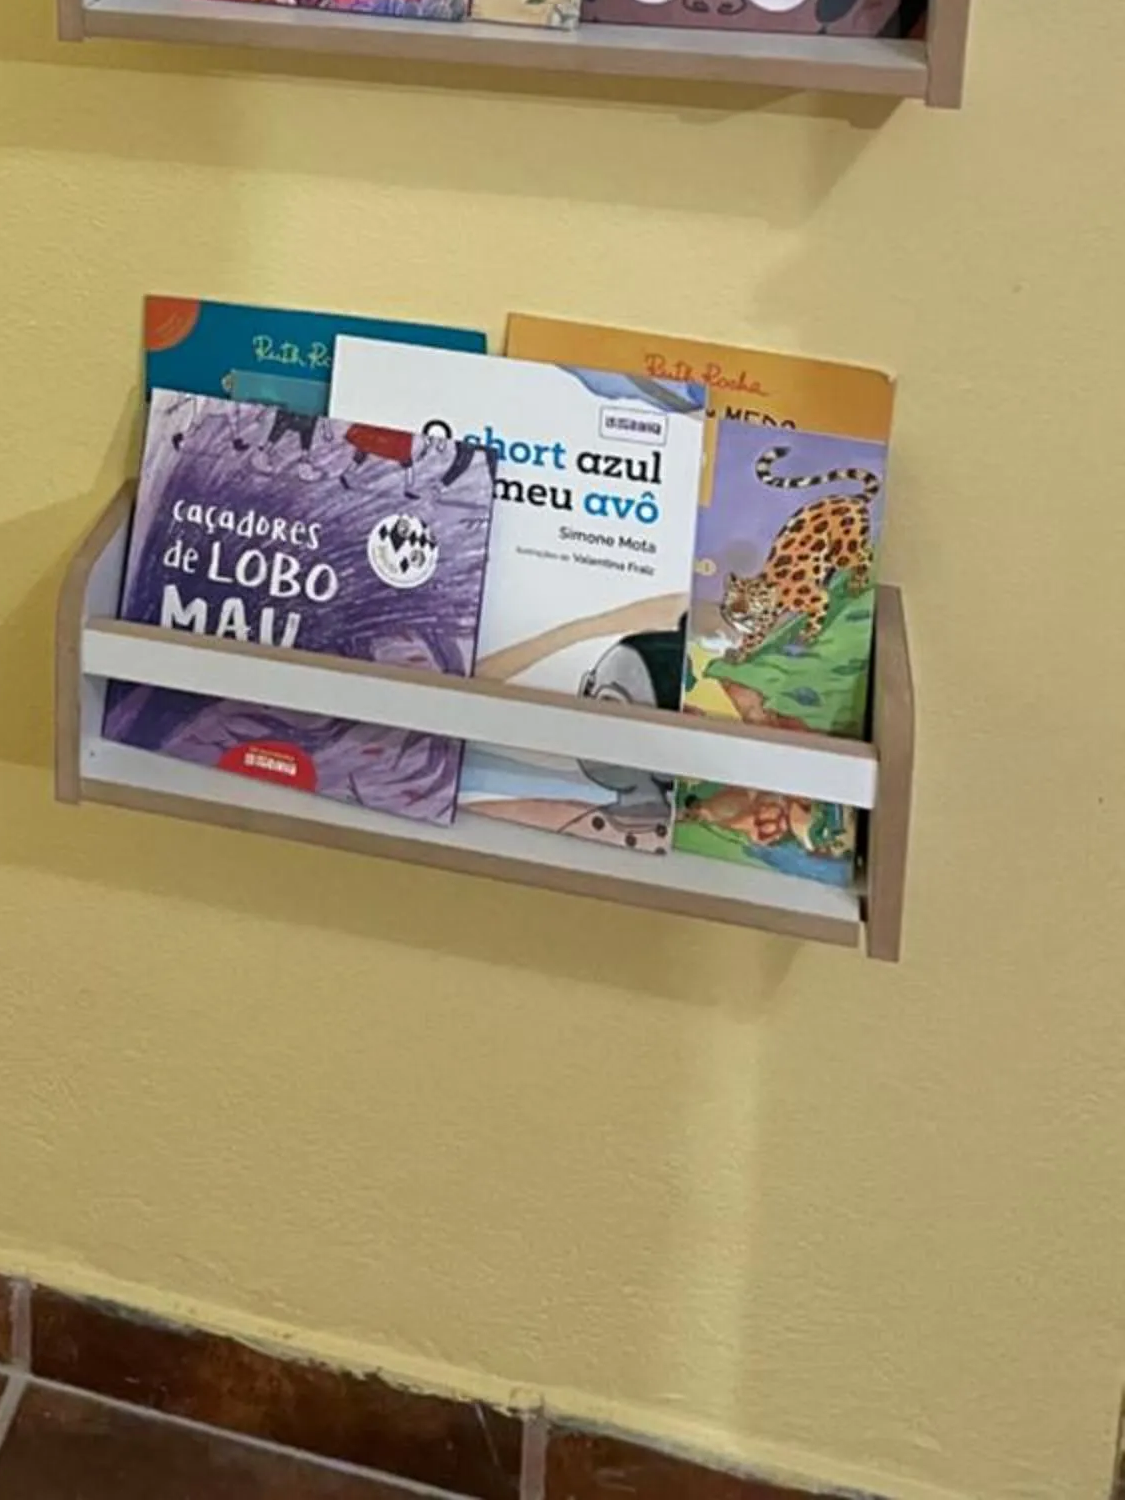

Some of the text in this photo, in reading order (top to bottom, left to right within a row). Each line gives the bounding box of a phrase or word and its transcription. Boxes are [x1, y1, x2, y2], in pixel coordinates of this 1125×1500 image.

[576, 451, 663, 485] azul
[491, 478, 660, 524] meu avô
[558, 526, 657, 554] Simone Mota
[163, 541, 198, 573] de
[208, 541, 339, 602] LOBO
[160, 584, 301, 650] MAU
